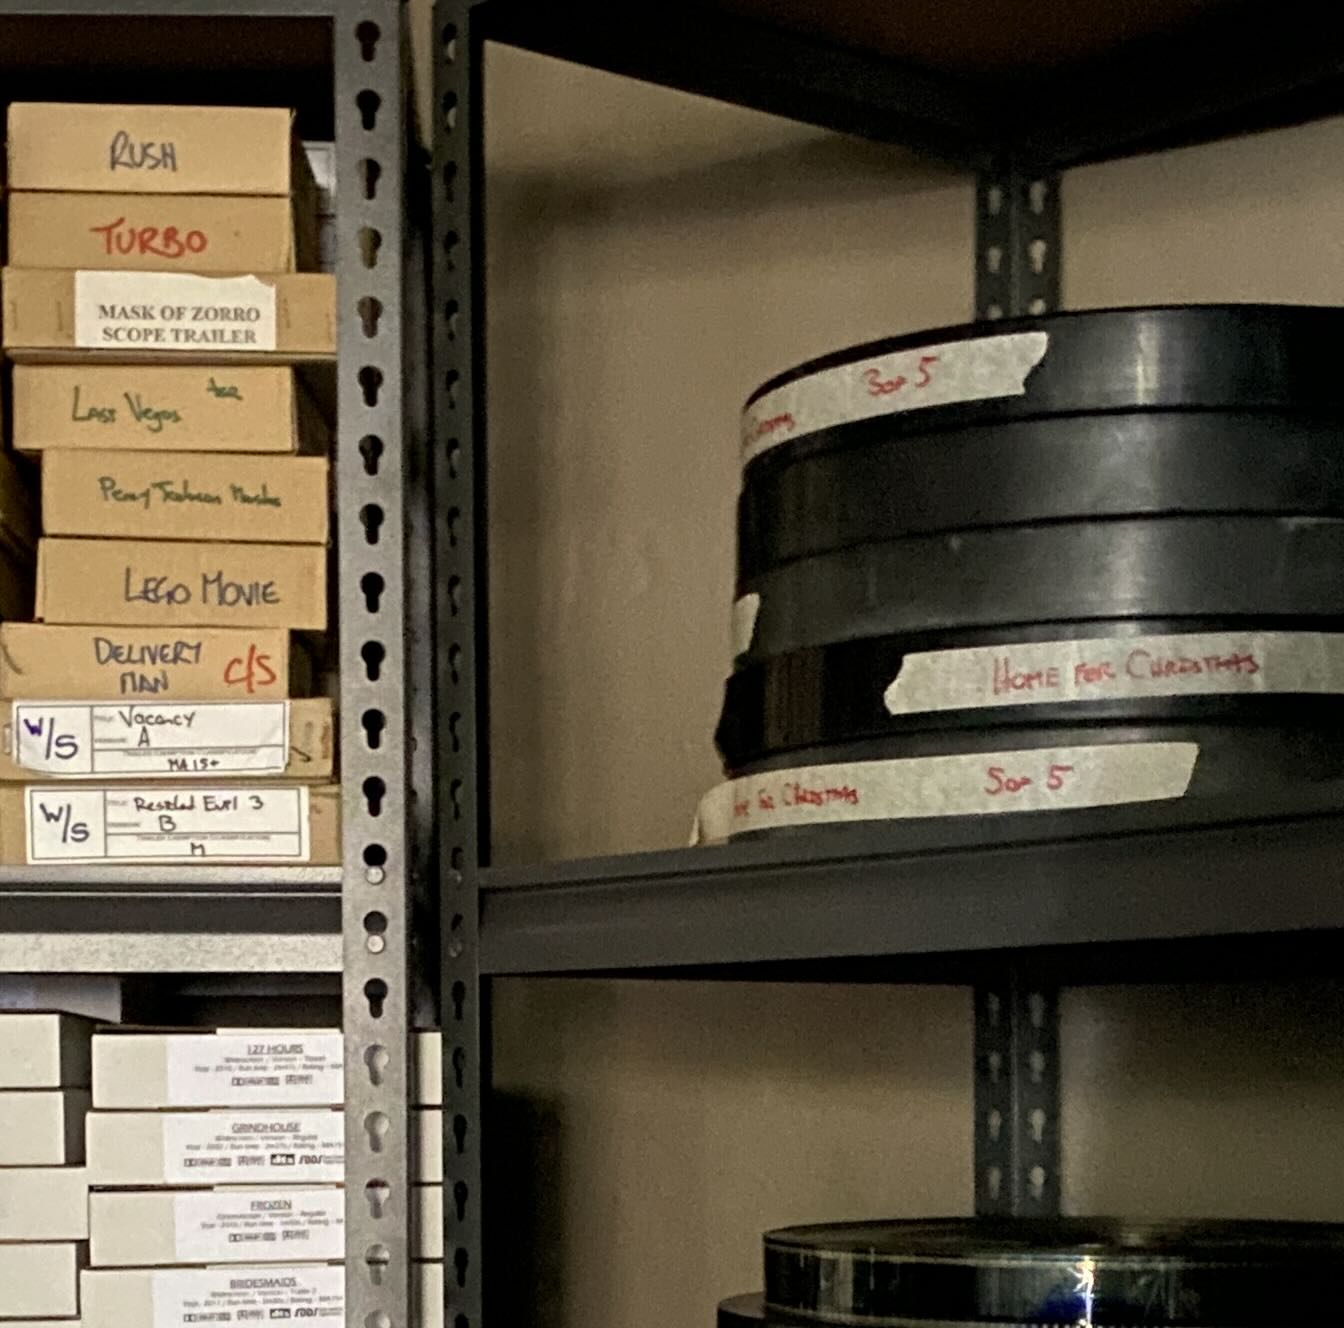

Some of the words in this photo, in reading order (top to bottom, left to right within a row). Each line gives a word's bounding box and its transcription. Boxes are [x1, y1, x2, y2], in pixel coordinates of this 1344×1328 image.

[110, 132, 176, 171] RUSH
[91, 218, 208, 257] TURBO
[99, 305, 145, 321] MASK
[153, 306, 187, 321] OF
[191, 306, 260, 322] ZORRO
[102, 327, 166, 342] SCOPE
[170, 327, 256, 343] TRAILER
[918, 356, 938, 388] 5
[125, 568, 190, 605] LEGO
[202, 573, 279, 605] MOVIE
[94, 638, 201, 666] DELIVERY
[120, 672, 168, 693] MAN
[991, 655, 1059, 694] HOME
[120, 710, 195, 731] Vacancy
[24, 717, 78, 759] W/S
[249, 796, 263, 810] 3
[41, 804, 90, 843] W/S
[273, 1043, 304, 1054] HOURS
[231, 1122, 301, 1132] GRINDHOUSE
[250, 1200, 291, 1210] FROZEN
[229, 1278, 296, 1288] BRIDESMAIDS
